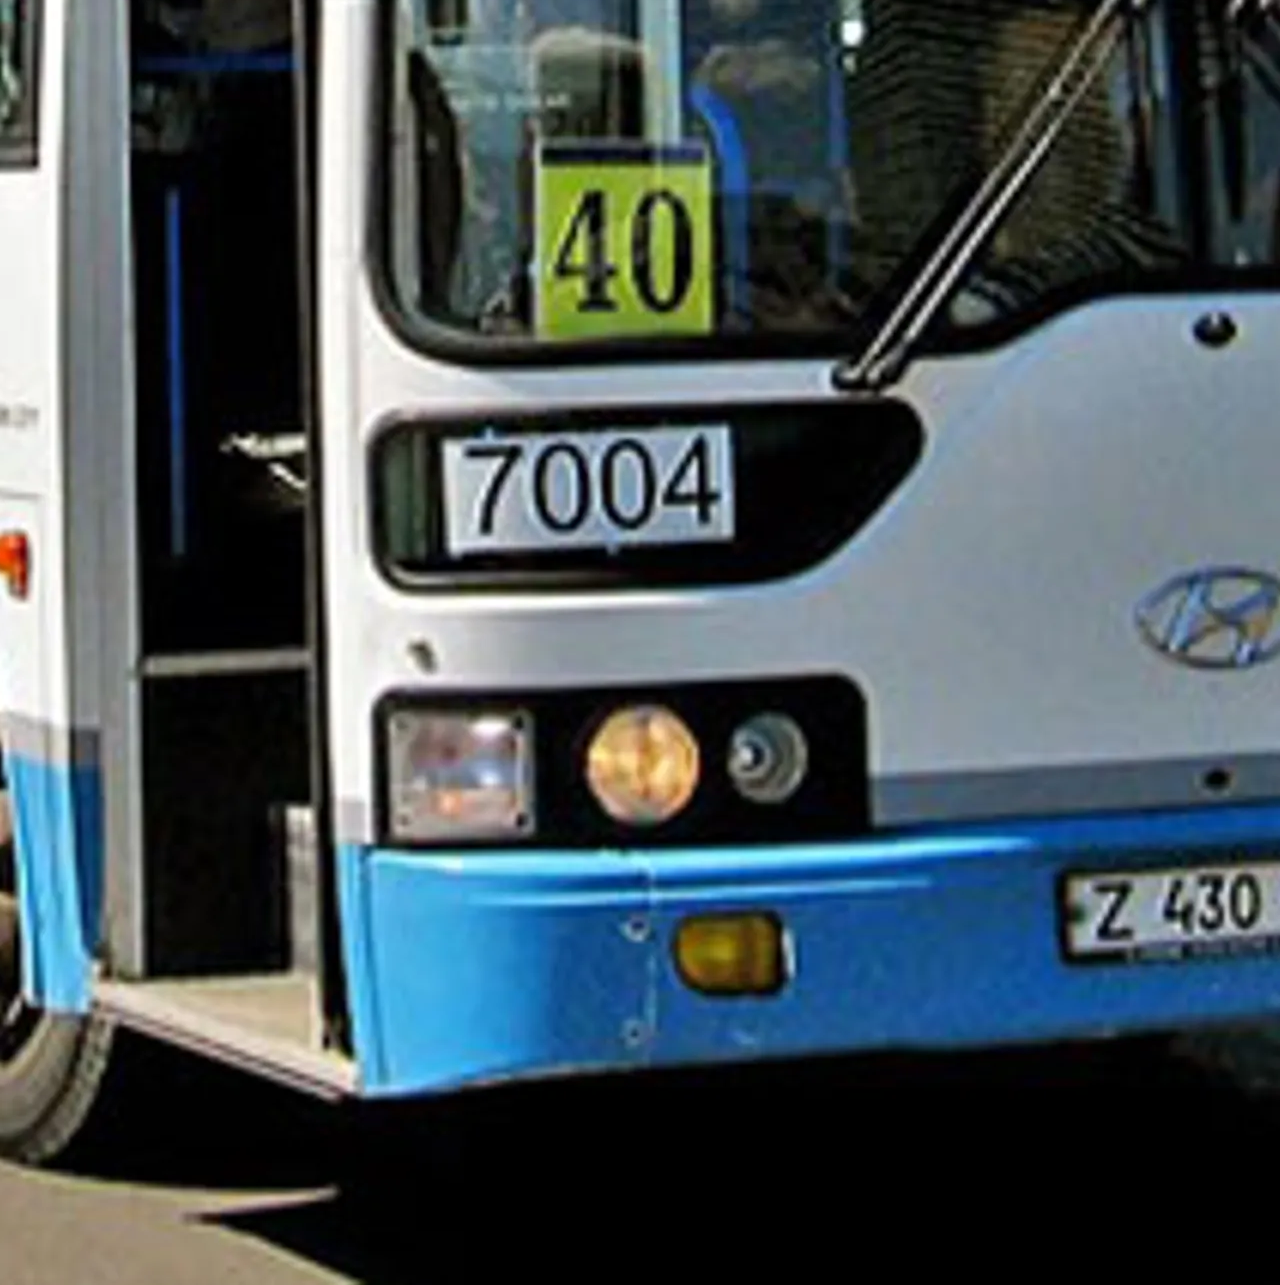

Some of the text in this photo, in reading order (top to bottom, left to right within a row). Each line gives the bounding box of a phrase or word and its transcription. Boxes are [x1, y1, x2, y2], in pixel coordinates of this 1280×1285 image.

[553, 188, 694, 314] 40
[463, 431, 720, 536] 7004
[1092, 880, 1134, 941] Z
[1162, 872, 1262, 934] 430
